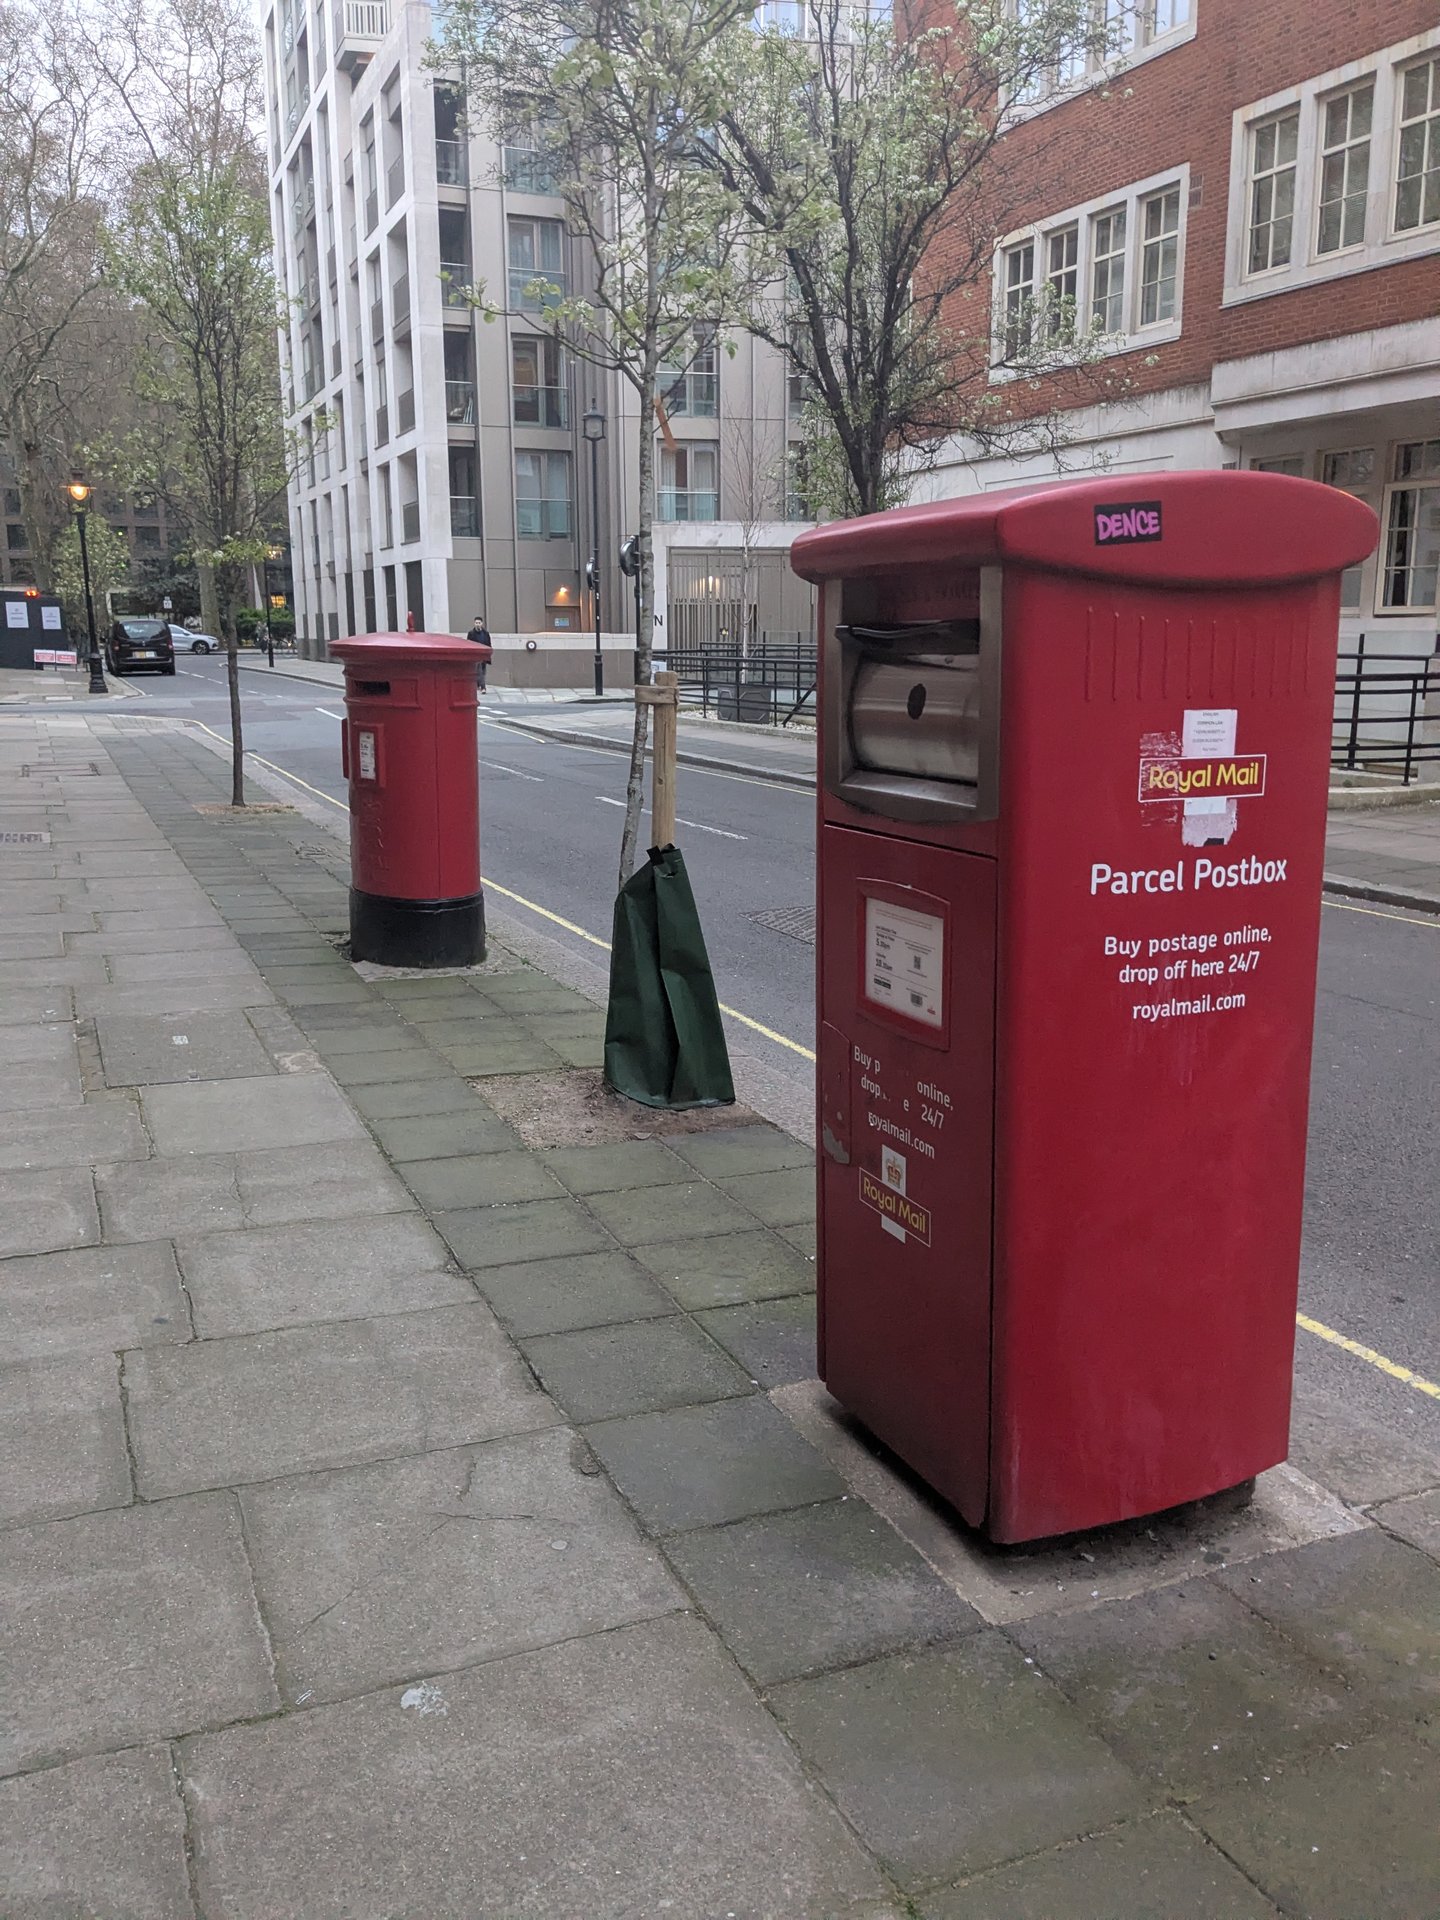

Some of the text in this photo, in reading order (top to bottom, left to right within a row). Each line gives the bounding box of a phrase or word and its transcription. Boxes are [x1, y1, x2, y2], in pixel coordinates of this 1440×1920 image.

[1096, 508, 1160, 541] DENCE
[1149, 762, 1259, 794] Royal Mail
[1090, 855, 1287, 895] Parcel Postbox
[1104, 925, 1272, 958] Buy postage online,
[1119, 951, 1260, 985] drop off here 24/7
[1132, 993, 1246, 1022] royalmail.com
[854, 1045, 872, 1069] Buy
[917, 1080, 954, 1111] online,
[861, 1074, 881, 1099] drop
[921, 1104, 945, 1129] 24/7
[863, 1176, 926, 1233] Royal Mail
